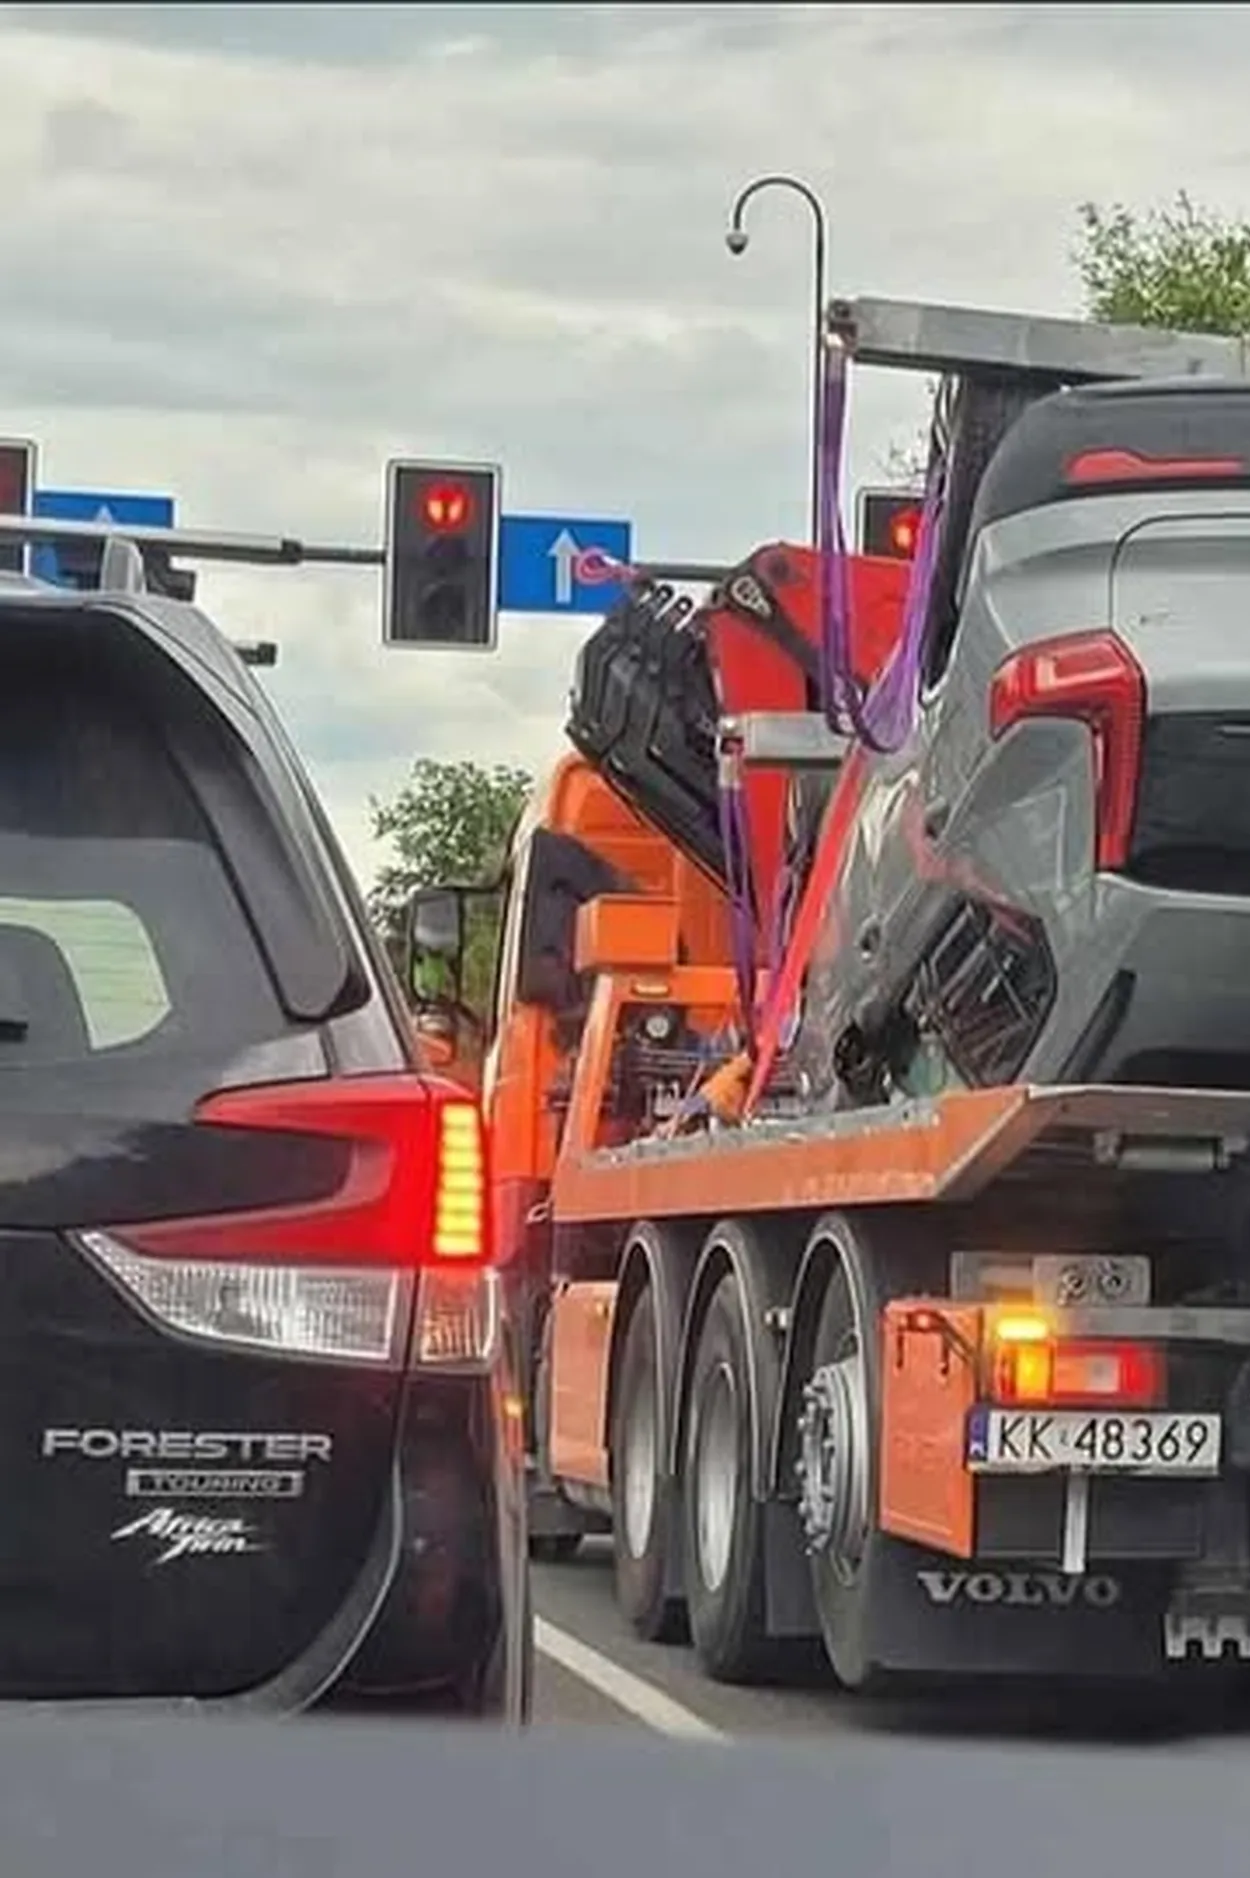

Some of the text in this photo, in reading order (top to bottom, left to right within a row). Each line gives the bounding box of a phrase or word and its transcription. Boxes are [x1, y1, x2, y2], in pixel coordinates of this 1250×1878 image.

[42, 1429, 333, 1461] FORESTER
[999, 1416, 1208, 1462] KK 48369
[917, 1571, 1120, 1606] VOLVO
